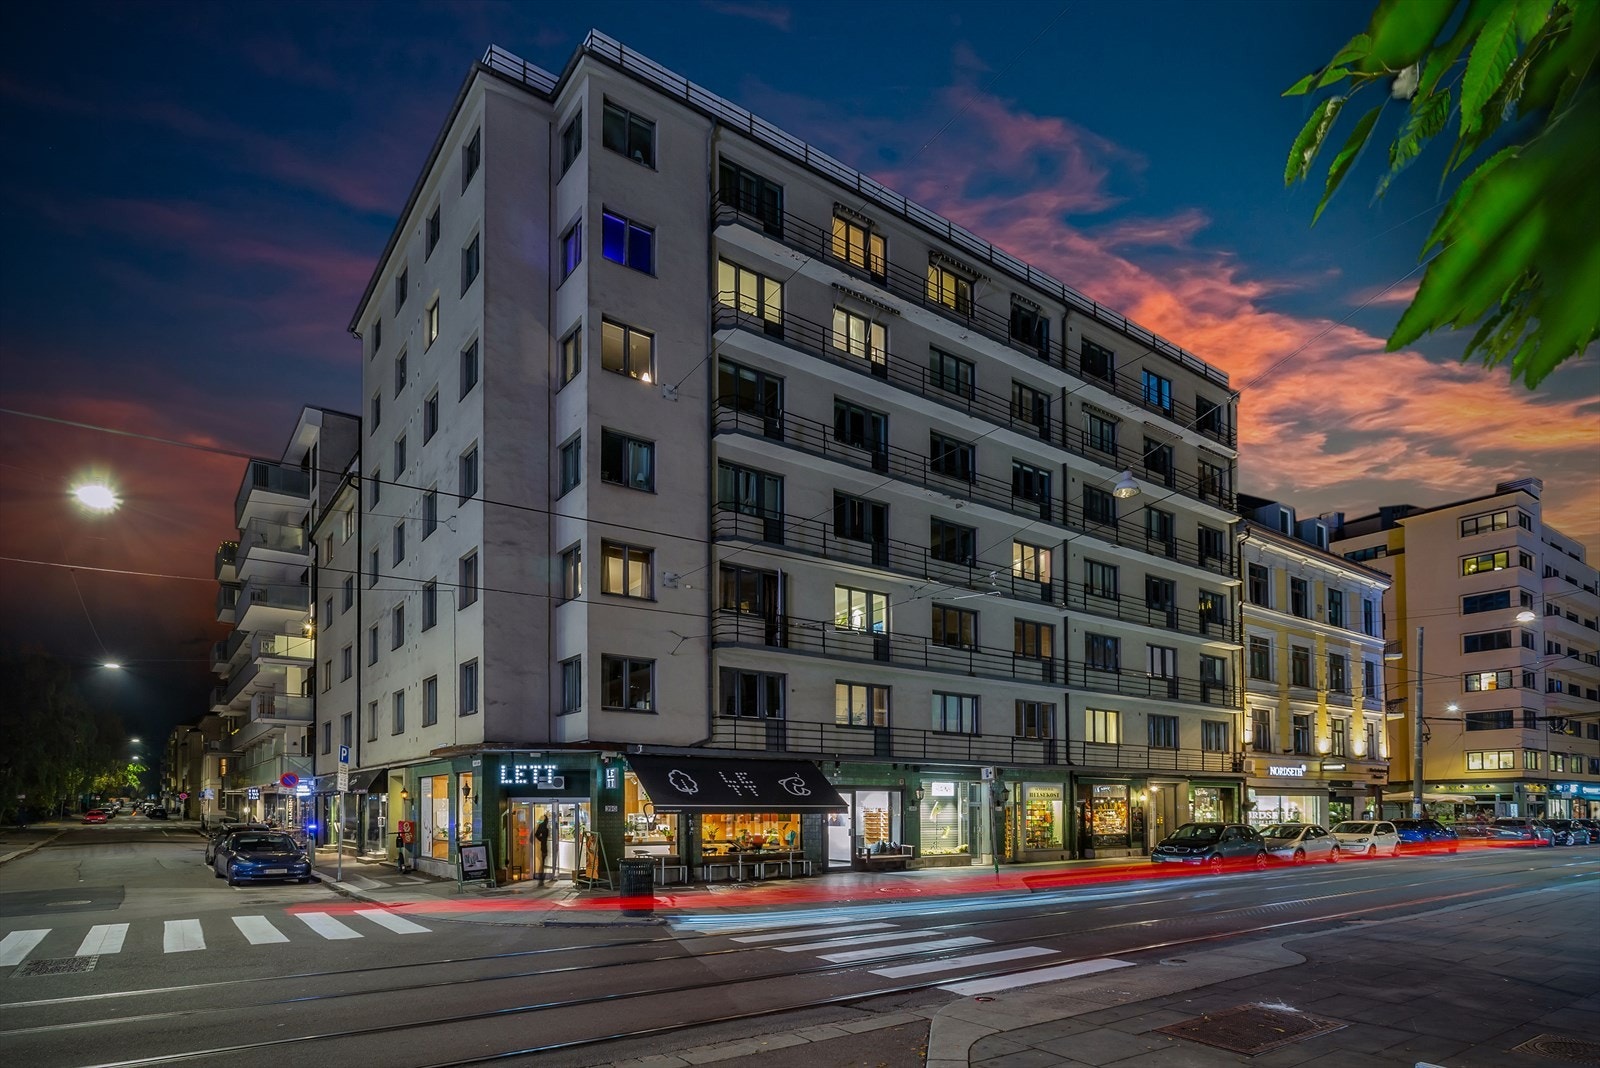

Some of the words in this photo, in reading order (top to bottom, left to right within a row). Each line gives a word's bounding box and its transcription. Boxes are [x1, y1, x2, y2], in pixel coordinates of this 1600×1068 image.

[341, 748, 347, 760] P
[500, 764, 558, 784] LETT
[606, 769, 615, 778] LE
[1269, 766, 1303, 776] NORDSETH
[606, 778, 615, 788] TT
